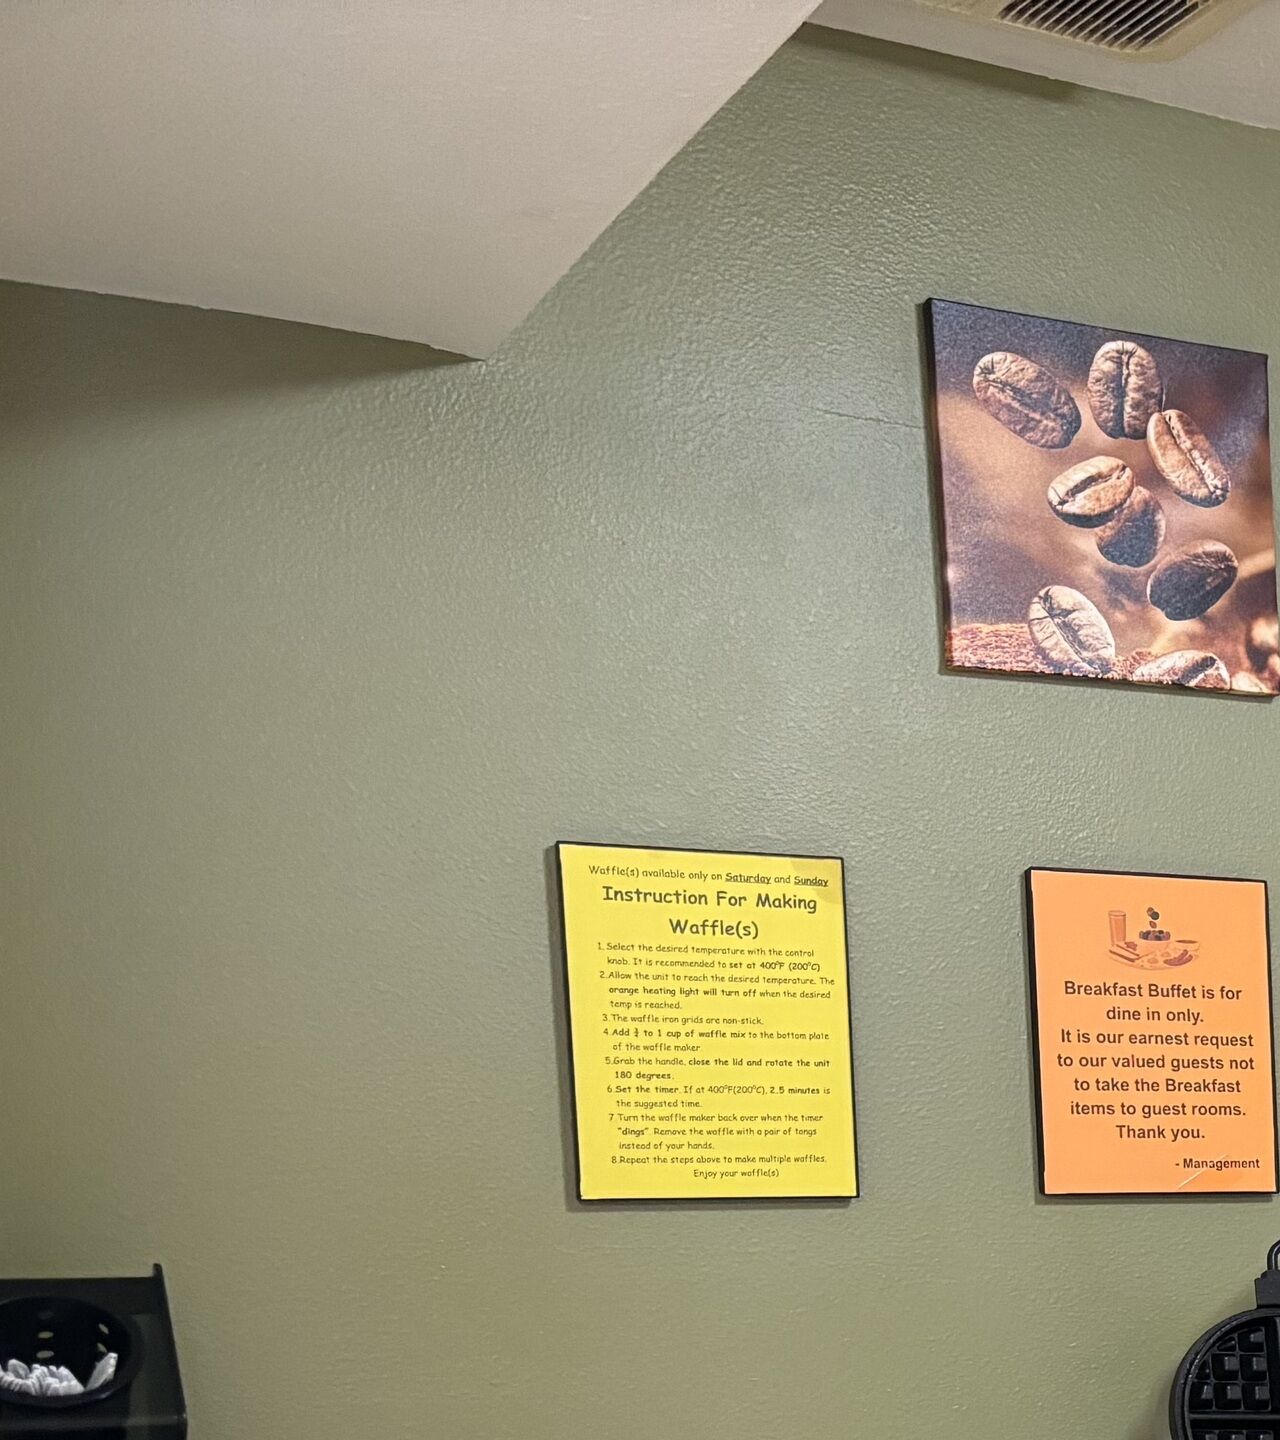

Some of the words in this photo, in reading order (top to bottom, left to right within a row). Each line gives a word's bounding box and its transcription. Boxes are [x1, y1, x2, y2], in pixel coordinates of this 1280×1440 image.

[589, 865, 639, 878] Waffle(s)
[642, 869, 685, 878] available
[689, 871, 708, 882] only
[725, 873, 771, 884] Saturday
[794, 876, 828, 887] Sunday
[602, 886, 708, 905] Instruction
[717, 891, 747, 906] For
[756, 893, 817, 914] Making
[669, 918, 758, 939] Waffle(s)
[656, 944, 688, 953] desired
[691, 946, 745, 956] temperature
[769, 948, 783, 956] the
[607, 957, 630, 966] knob.
[633, 958, 642, 966] It
[646, 958, 652, 966] is
[656, 960, 714, 968] recommended
[634, 972, 649, 980] the
[711, 974, 725, 983] the
[728, 975, 759, 983] desired
[763, 976, 816, 986] temperature.
[609, 987, 639, 996] orange
[643, 986, 675, 997] heating
[680, 987, 699, 997] light
[703, 988, 717, 996] will
[743, 989, 757, 997] off
[760, 989, 780, 998] when
[800, 991, 830, 999] desired
[1064, 981, 1143, 998] Breakfast
[1148, 984, 1196, 999] Buffet
[1202, 986, 1215, 999] is
[1220, 986, 1242, 1000] for
[610, 1000, 632, 1010] temp
[645, 1001, 682, 1009] reached.
[1106, 1007, 1141, 1021] dine
[1146, 1008, 1160, 1021] in
[1166, 1008, 1204, 1025] only.
[1061, 1029, 1071, 1043] It
[1078, 1029, 1090, 1043] is
[1096, 1033, 1123, 1044] our
[1129, 1032, 1189, 1045] earnest
[1194, 1034, 1254, 1049] request
[613, 1042, 622, 1051] of
[643, 1043, 671, 1051] waffle
[1057, 1054, 1073, 1067] to
[1079, 1056, 1106, 1067] our
[1112, 1054, 1165, 1068] valued
[1171, 1057, 1224, 1072] guests
[1229, 1057, 1254, 1070] not
[615, 1071, 632, 1079] 180
[636, 1071, 674, 1081] degrees.
[1074, 1078, 1090, 1091] to
[1095, 1078, 1129, 1091] take
[1135, 1078, 1159, 1092] the
[1166, 1078, 1241, 1093] Breakfast
[1070, 1101, 1115, 1115] items
[1120, 1103, 1136, 1115] to
[1142, 1103, 1187, 1119] guest
[1192, 1105, 1246, 1116] rooms.
[764, 1128, 780, 1137] pair
[796, 1128, 817, 1137] tongs
[1116, 1125, 1166, 1139] Thank
[1171, 1128, 1205, 1143] you.
[654, 1141, 663, 1149] of
[688, 1141, 714, 1150] hands.
[1183, 1158, 1260, 1171] Management
[693, 1169, 717, 1179] Enjoy
[741, 1169, 779, 1178] waffle(s)
